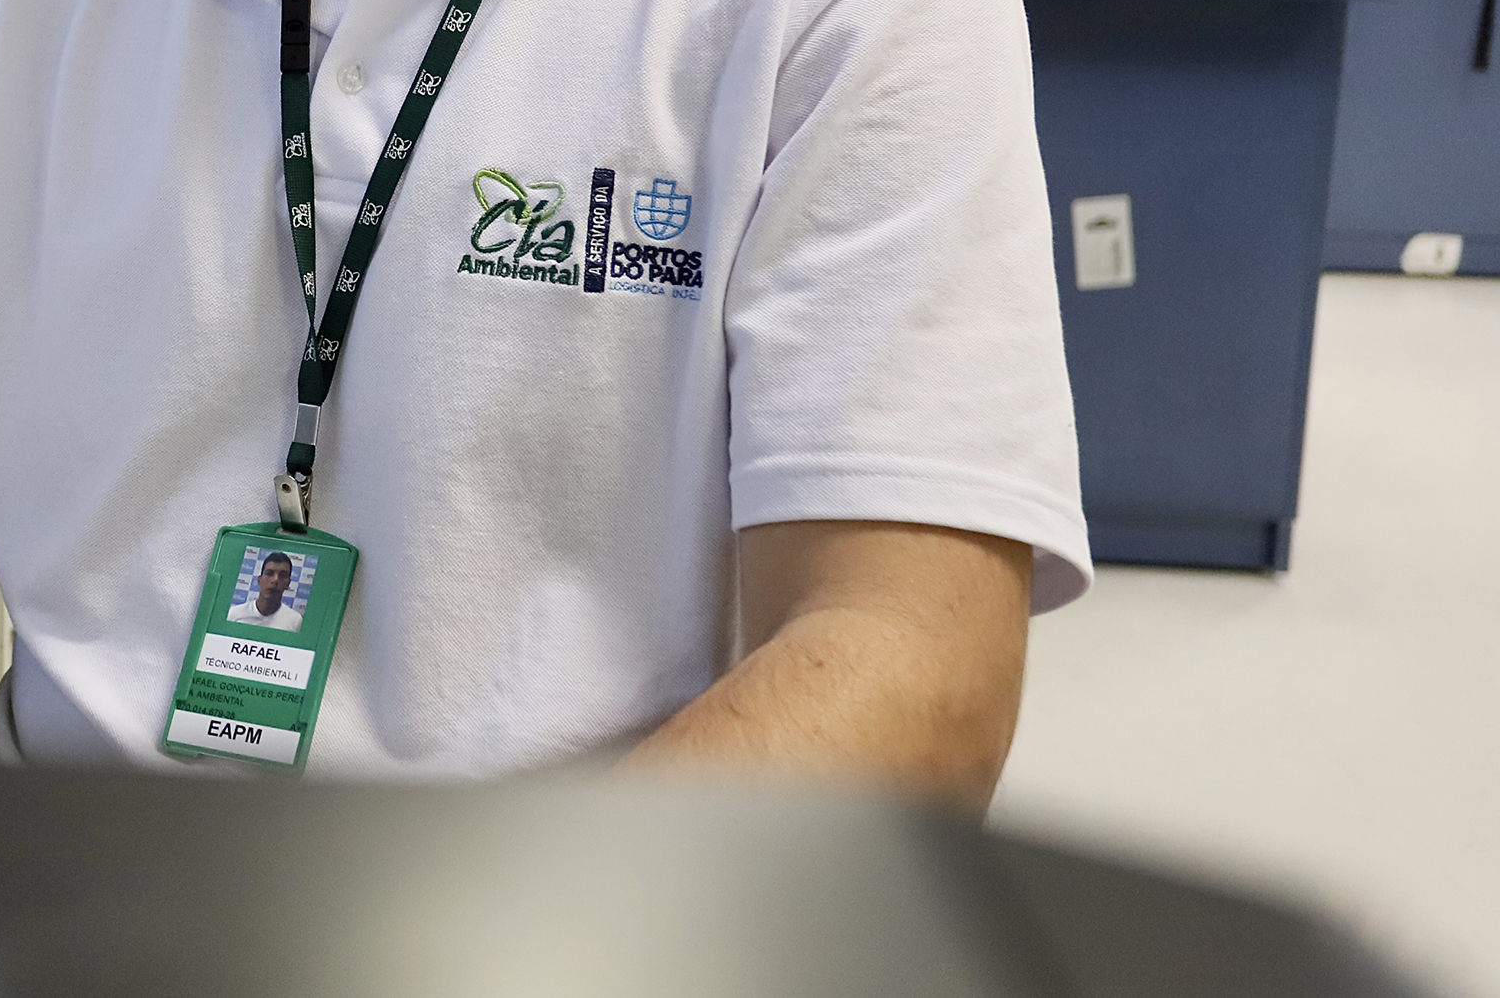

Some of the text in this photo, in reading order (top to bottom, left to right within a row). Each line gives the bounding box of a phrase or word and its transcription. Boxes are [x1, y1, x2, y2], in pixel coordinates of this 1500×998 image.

[595, 186, 610, 204] DA
[470, 198, 576, 263] Cia
[612, 242, 702, 270] PORTOS
[457, 254, 580, 286] Ambiental
[589, 264, 603, 276] A
[611, 260, 644, 280] DO
[230, 642, 282, 662] RAFAEL
[205, 657, 242, 671] TÉCNICO
[243, 665, 292, 681] AMBIENTAL
[197, 690, 245, 707] AMBIENTAL
[220, 682, 274, 699] GONÇALVES
[207, 719, 263, 745] EAPM
